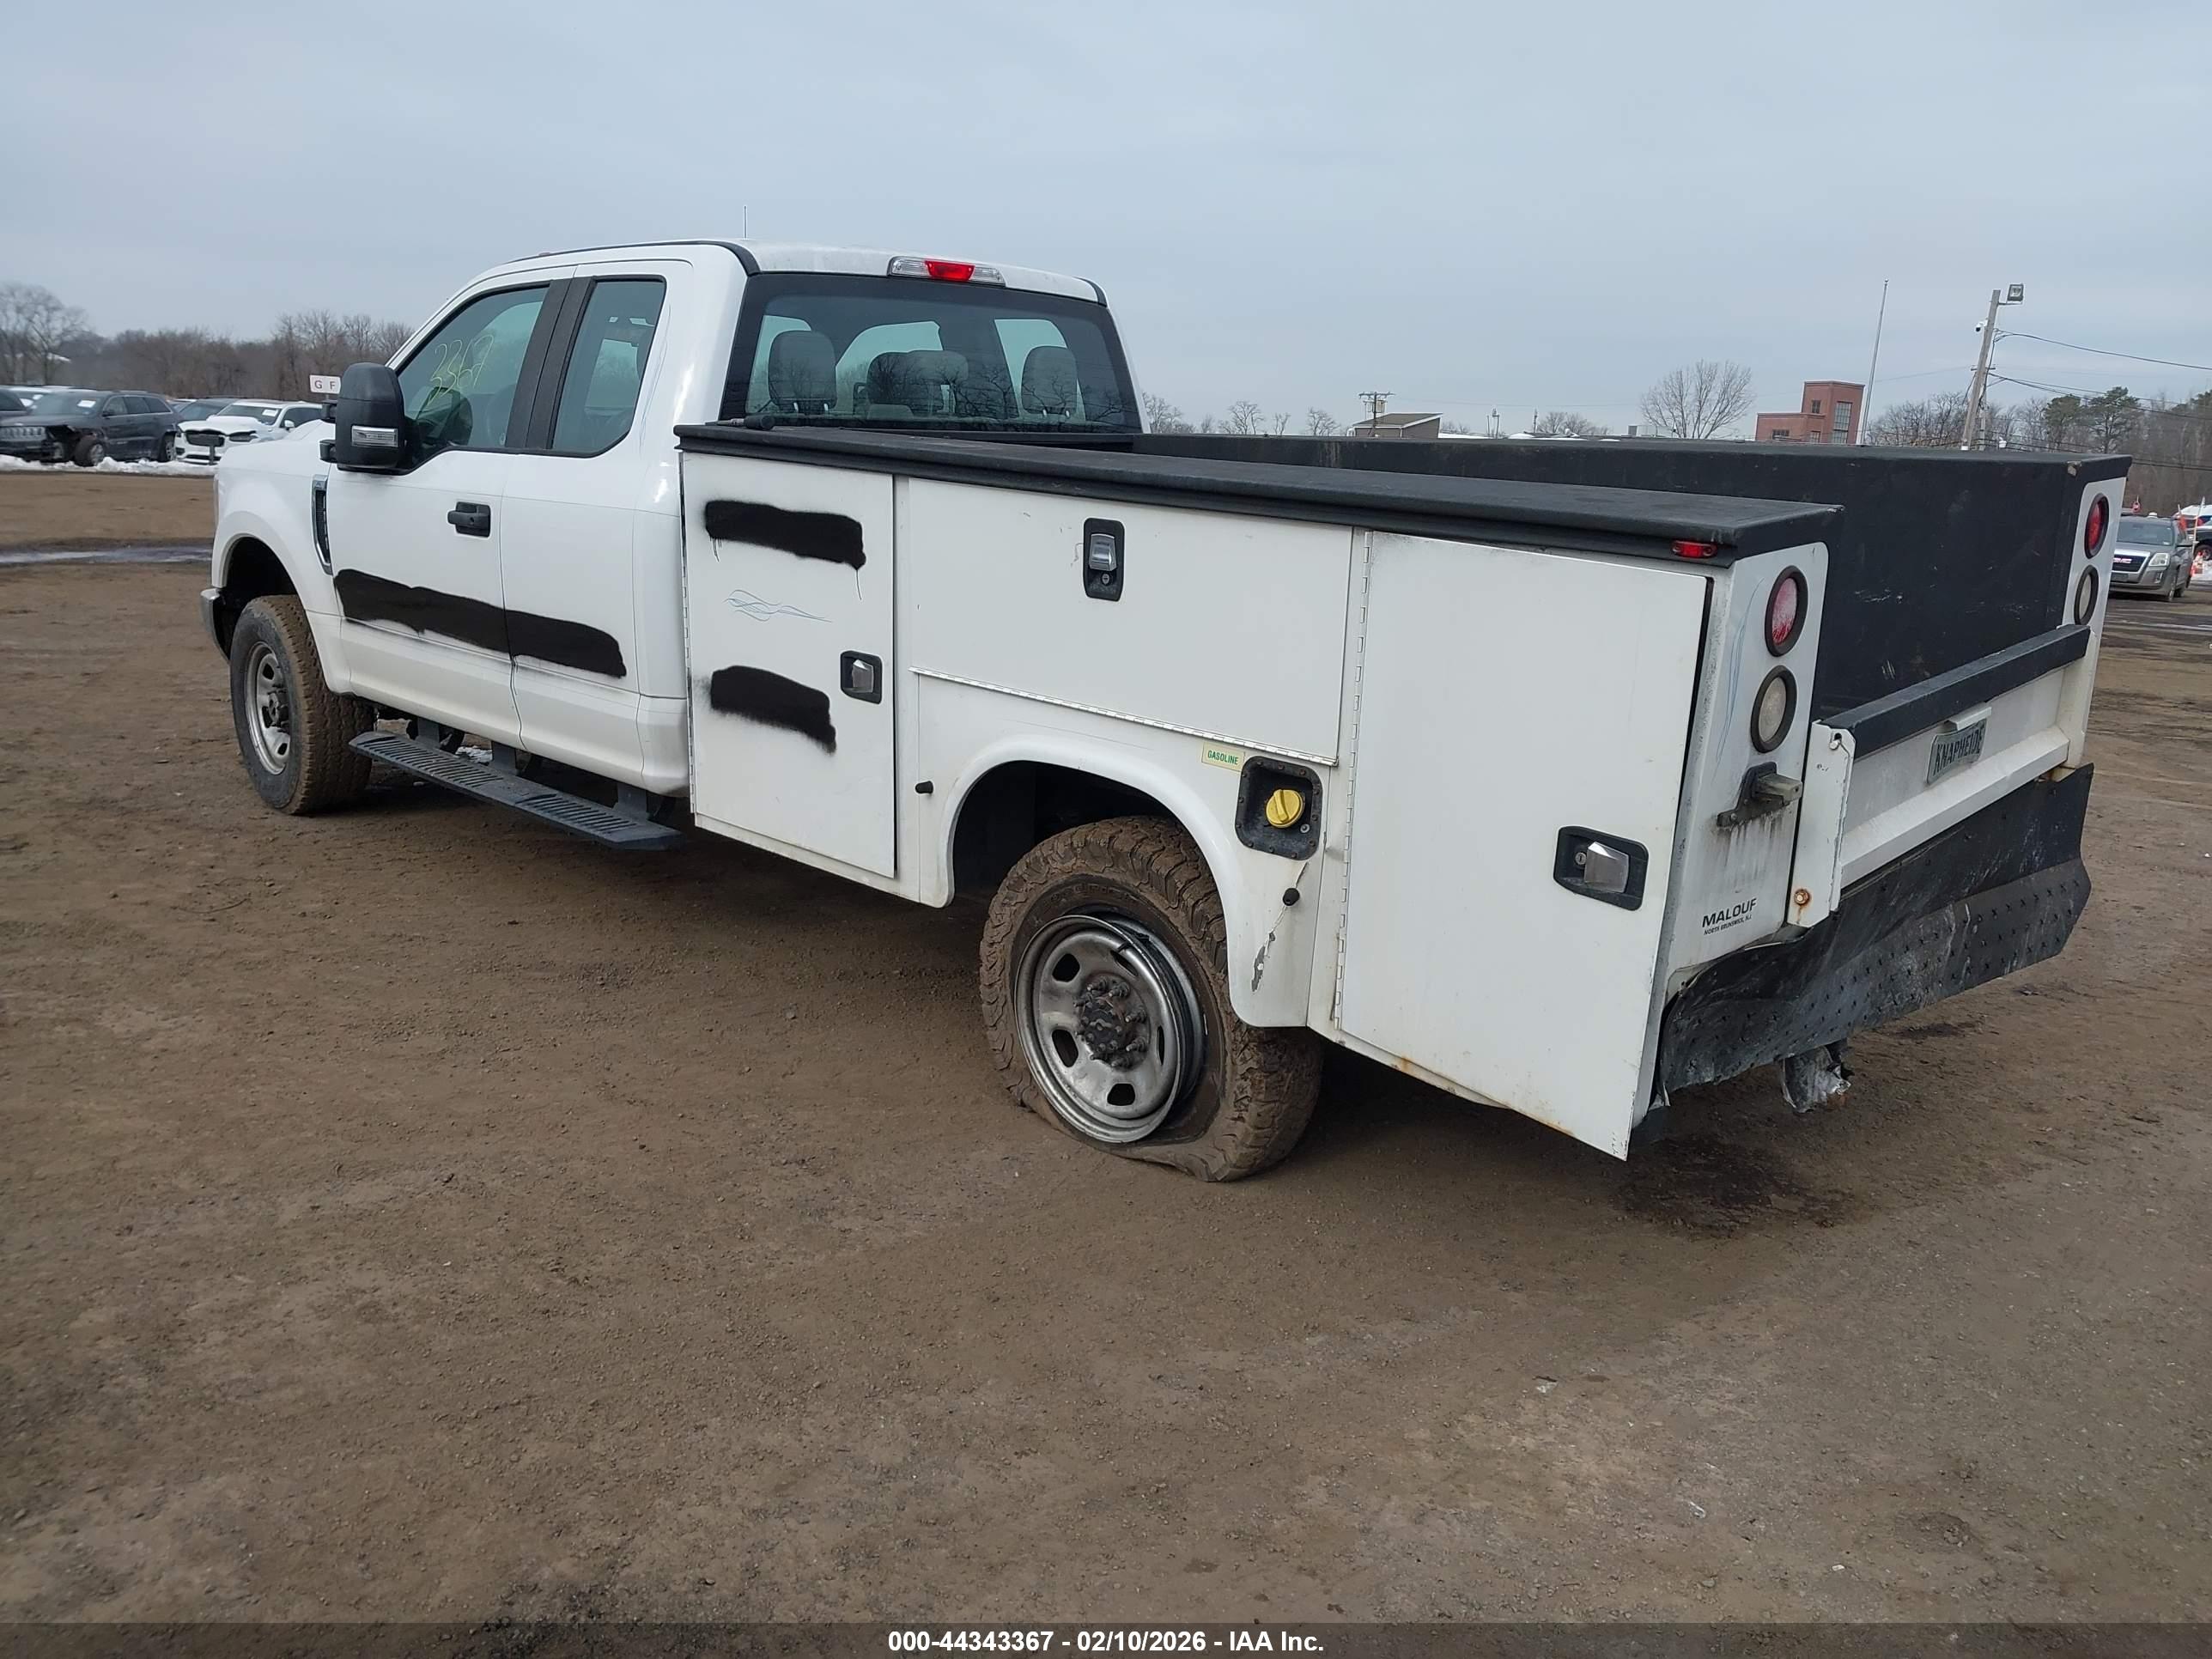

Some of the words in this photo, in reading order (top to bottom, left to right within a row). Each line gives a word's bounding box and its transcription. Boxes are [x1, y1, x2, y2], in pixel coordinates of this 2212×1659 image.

[1207, 750, 1239, 766] GASOLINE
[1933, 725, 1985, 776] KNAPHEIDE
[1702, 897, 1757, 928] MALOUF
[1704, 926, 1721, 936] NORTH
